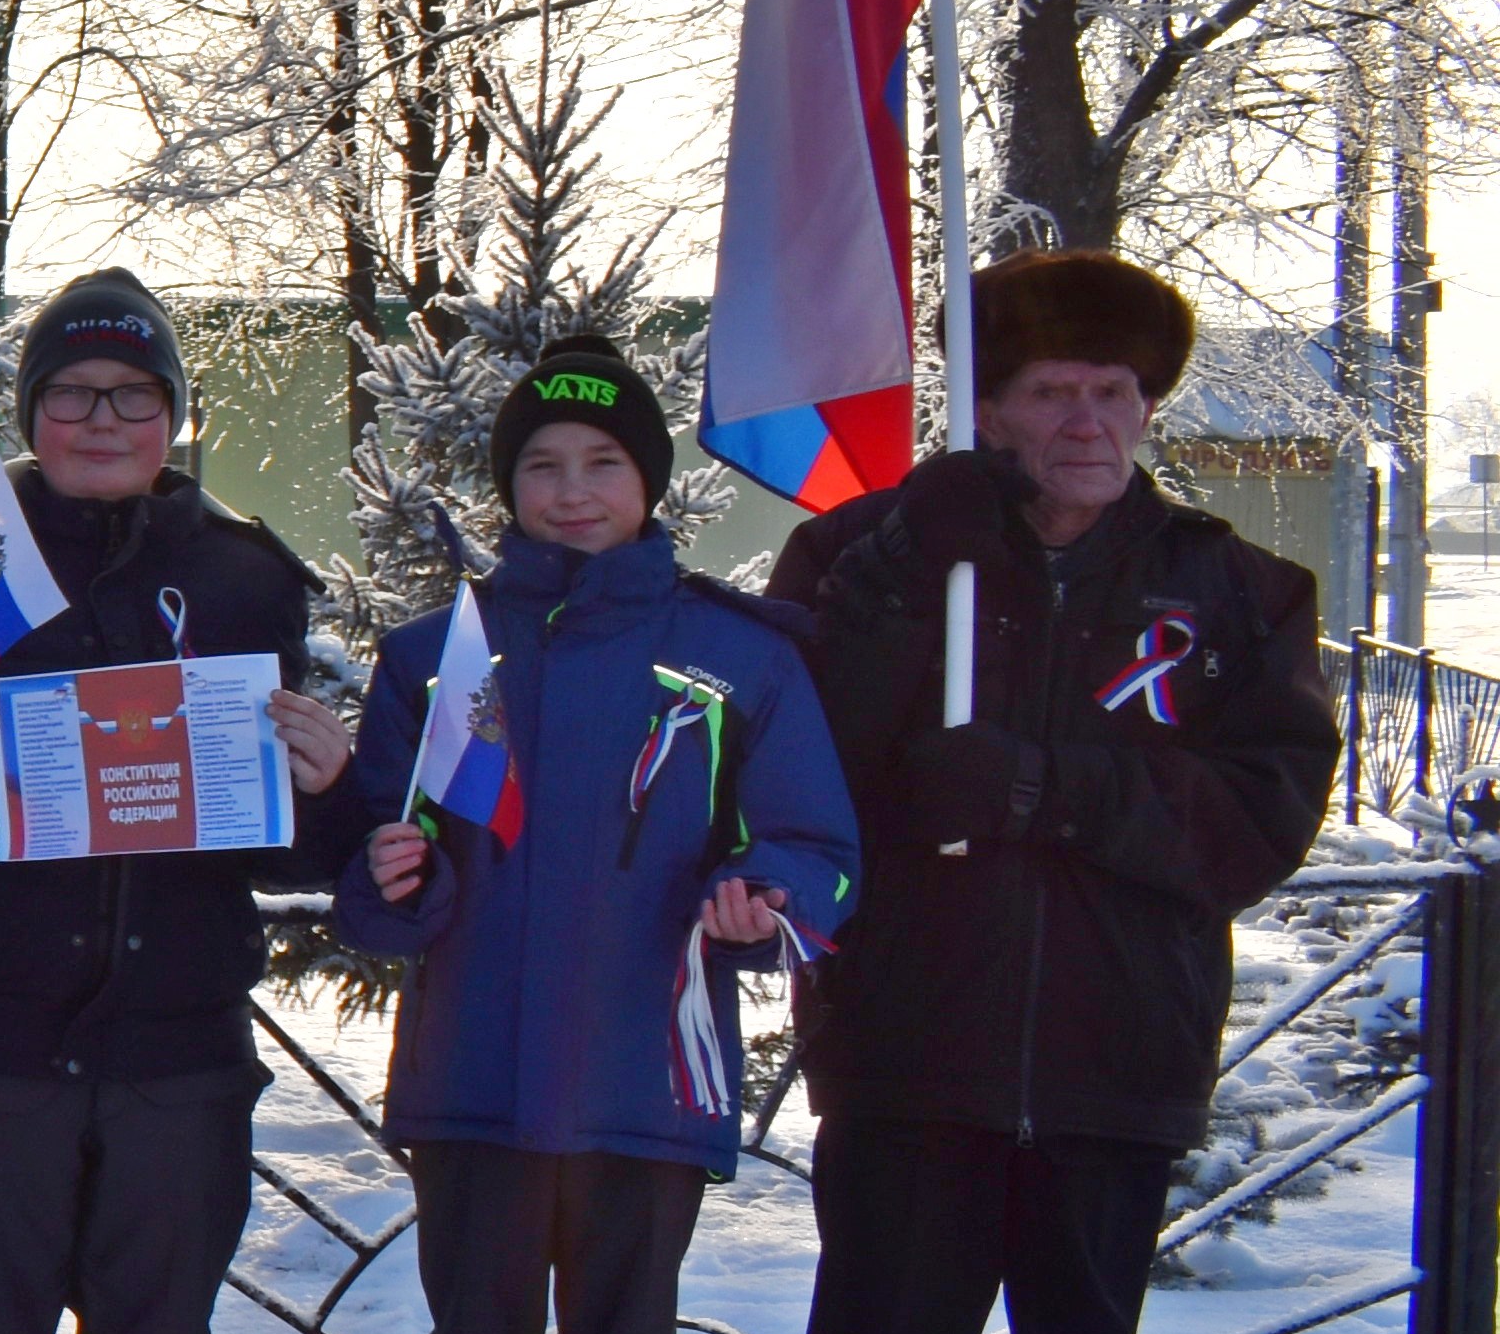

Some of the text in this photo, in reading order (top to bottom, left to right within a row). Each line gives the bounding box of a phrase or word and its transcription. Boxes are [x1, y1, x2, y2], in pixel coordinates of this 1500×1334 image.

[532, 374, 619, 406] VANS
[100, 762, 181, 782] КОНСТИТУЦИЯ
[104, 780, 180, 803] РОССИЙСКОЙ
[109, 804, 178, 825] ФЕДЕРАЦИИ
